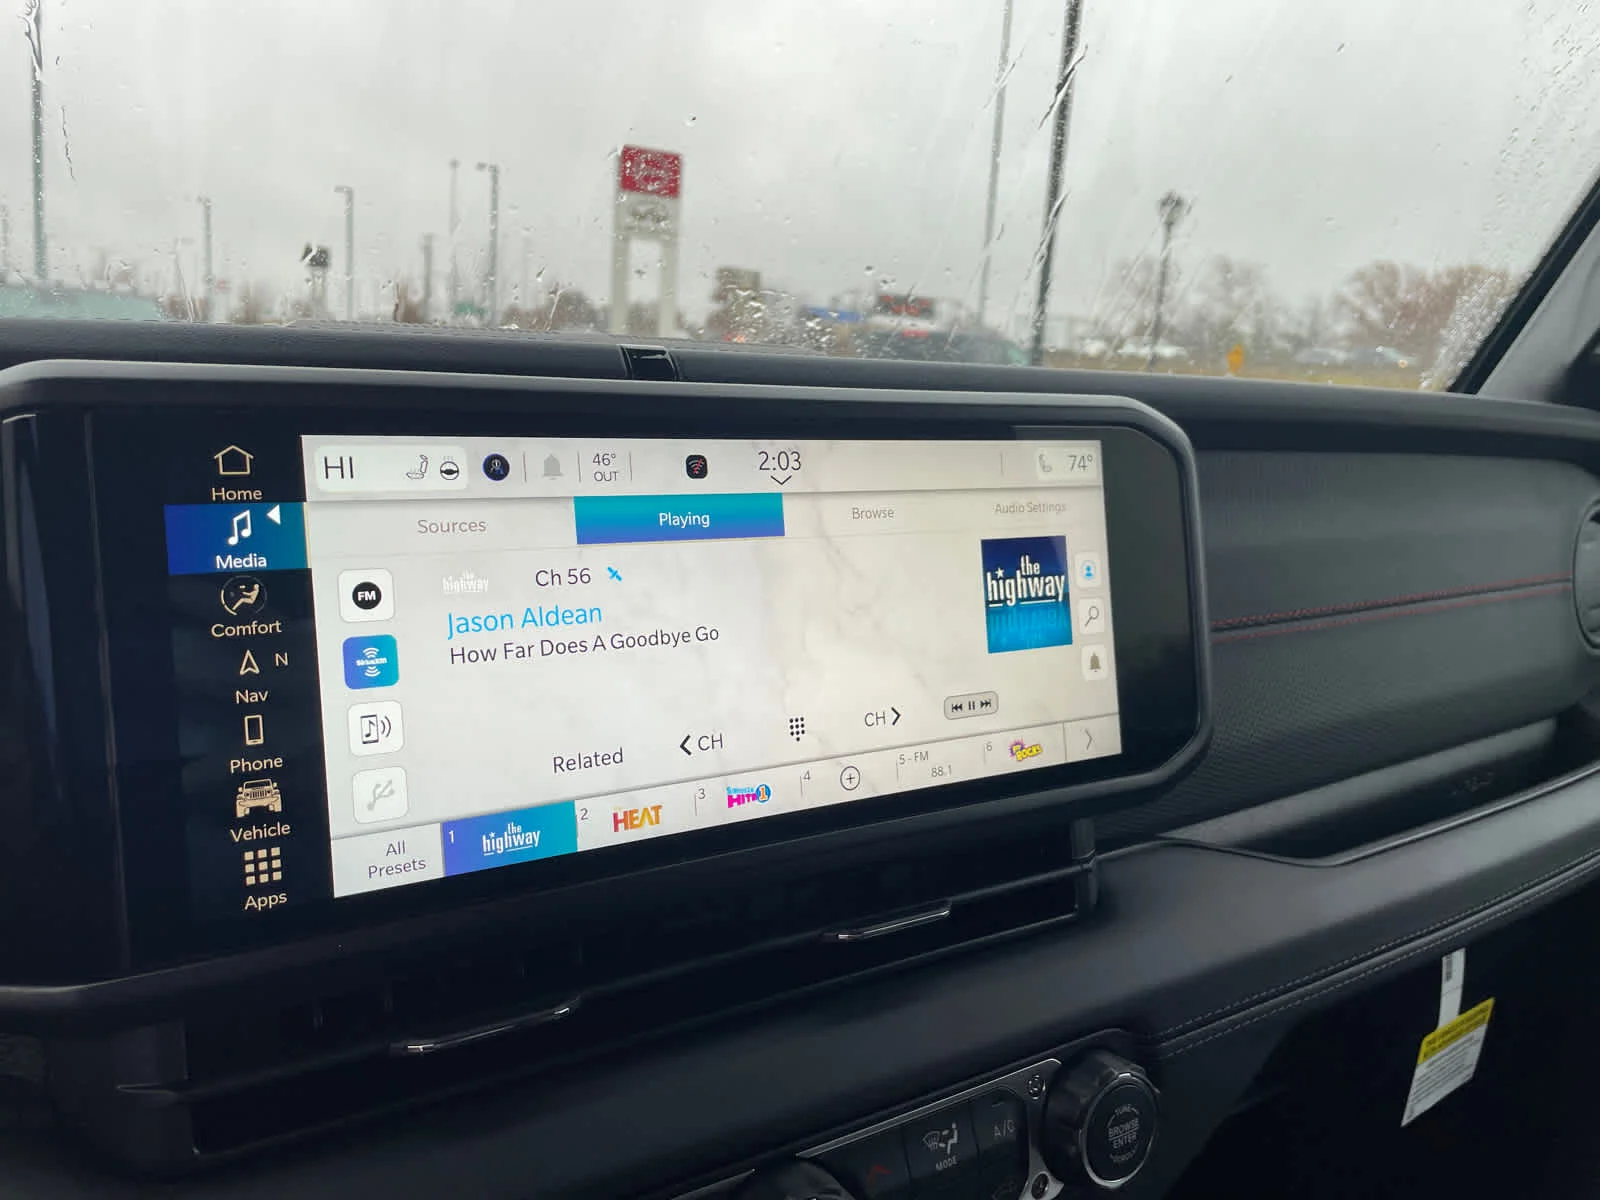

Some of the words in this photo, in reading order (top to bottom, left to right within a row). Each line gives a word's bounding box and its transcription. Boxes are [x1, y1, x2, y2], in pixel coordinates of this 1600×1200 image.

[324, 455, 355, 480] HI
[592, 452, 617, 467] 46°
[758, 450, 802, 472] 2:03
[1067, 454, 1094, 472] 74°
[593, 471, 619, 482] OUT
[211, 487, 263, 502] Home
[851, 506, 895, 520] Browse
[994, 501, 1025, 515] Audio
[1027, 501, 1068, 515] Settings
[417, 518, 487, 534] Sources
[658, 511, 711, 529] Playing
[215, 553, 268, 569] Media
[1020, 554, 1041, 576] the
[535, 568, 562, 587] Ch
[567, 567, 592, 585] 56
[357, 590, 377, 601] FM
[986, 570, 1067, 606] highway
[211, 619, 282, 638] Comfort
[447, 609, 514, 640] Jason
[520, 604, 603, 630] Aldean
[450, 644, 497, 665] How
[503, 641, 535, 660] Far
[540, 637, 588, 657] Does
[592, 635, 607, 652] A
[610, 627, 692, 651] Goodbye
[695, 625, 720, 643] Go
[275, 652, 289, 667] N
[235, 688, 269, 704] Nav
[864, 711, 886, 728] CH
[697, 733, 724, 752] CH
[986, 742, 993, 751] 6
[230, 755, 284, 774] Phone
[552, 747, 625, 774] Related
[899, 754, 906, 765] 5
[914, 751, 929, 762] FM
[803, 771, 811, 782] 4
[931, 765, 952, 777] 88.1
[698, 787, 706, 800] 3
[580, 808, 589, 821] 2
[612, 804, 663, 833] HEAT
[230, 821, 291, 843] Vehicle
[506, 821, 522, 835] the
[448, 830, 455, 844] 1
[482, 828, 541, 854] highway
[385, 840, 407, 857] All
[367, 857, 427, 880] Presets
[244, 891, 288, 912] Apps
[1112, 1132, 1137, 1149] ENTER
[935, 1155, 958, 1171] MODE
